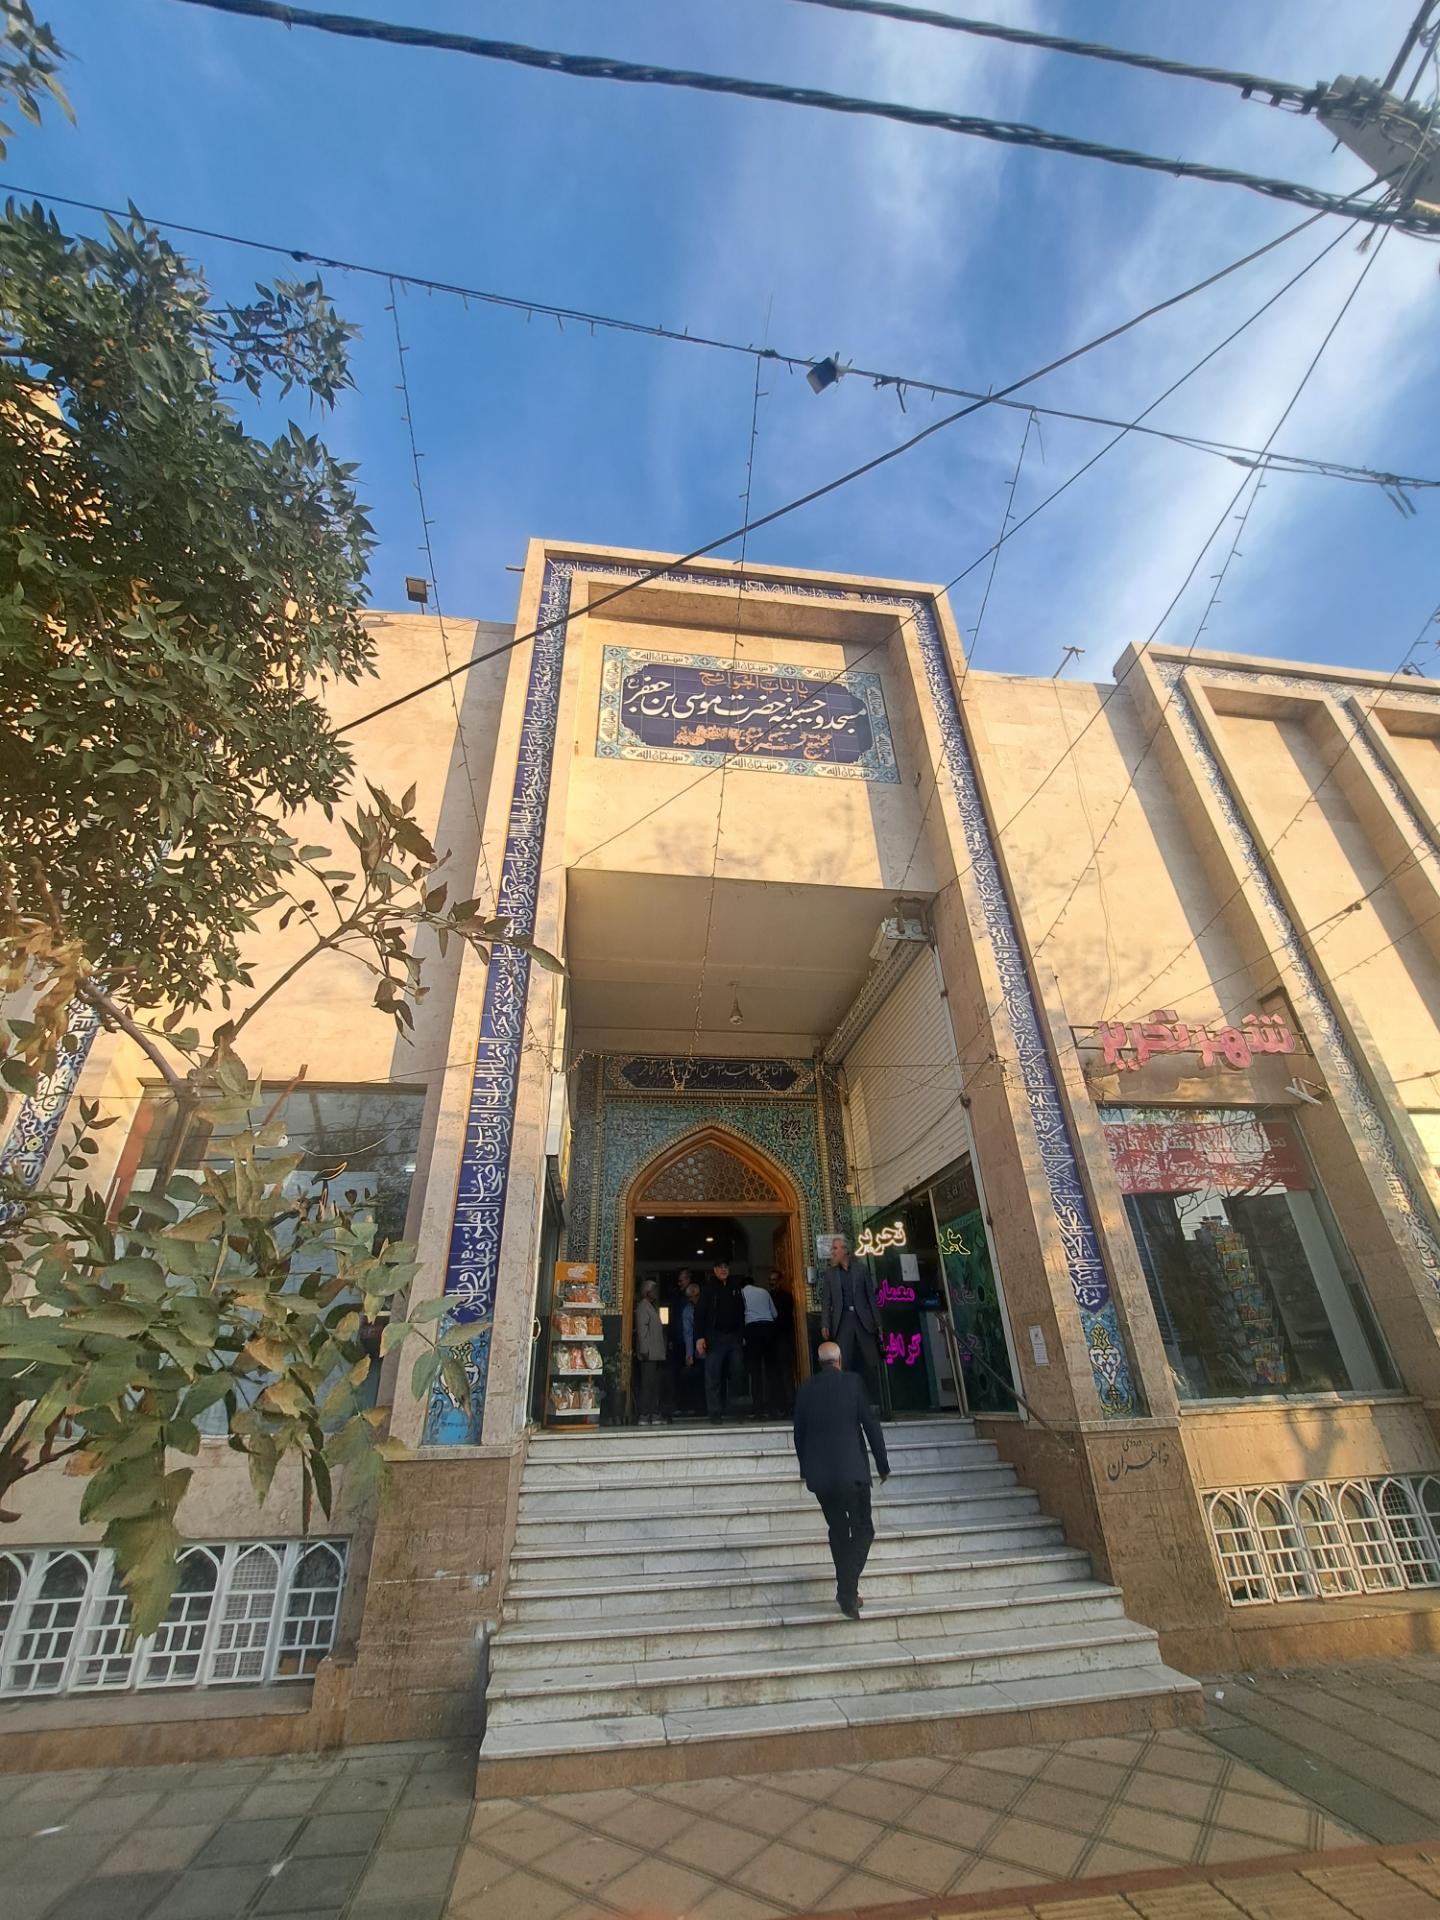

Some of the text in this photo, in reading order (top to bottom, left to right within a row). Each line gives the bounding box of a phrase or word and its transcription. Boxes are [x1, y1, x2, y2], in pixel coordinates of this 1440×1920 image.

[624, 677, 671, 711] جعفر
[641, 689, 677, 718] بن
[672, 692, 721, 719] موسی
[714, 695, 785, 724] حضرت
[768, 697, 827, 729] حسینیه
[812, 715, 823, 730] و
[829, 706, 867, 733] مسجد
[1094, 1009, 1296, 1073] شهر تحریر
[854, 1221, 907, 1257] تحریر
[1107, 1442, 1170, 1482] خواهران
